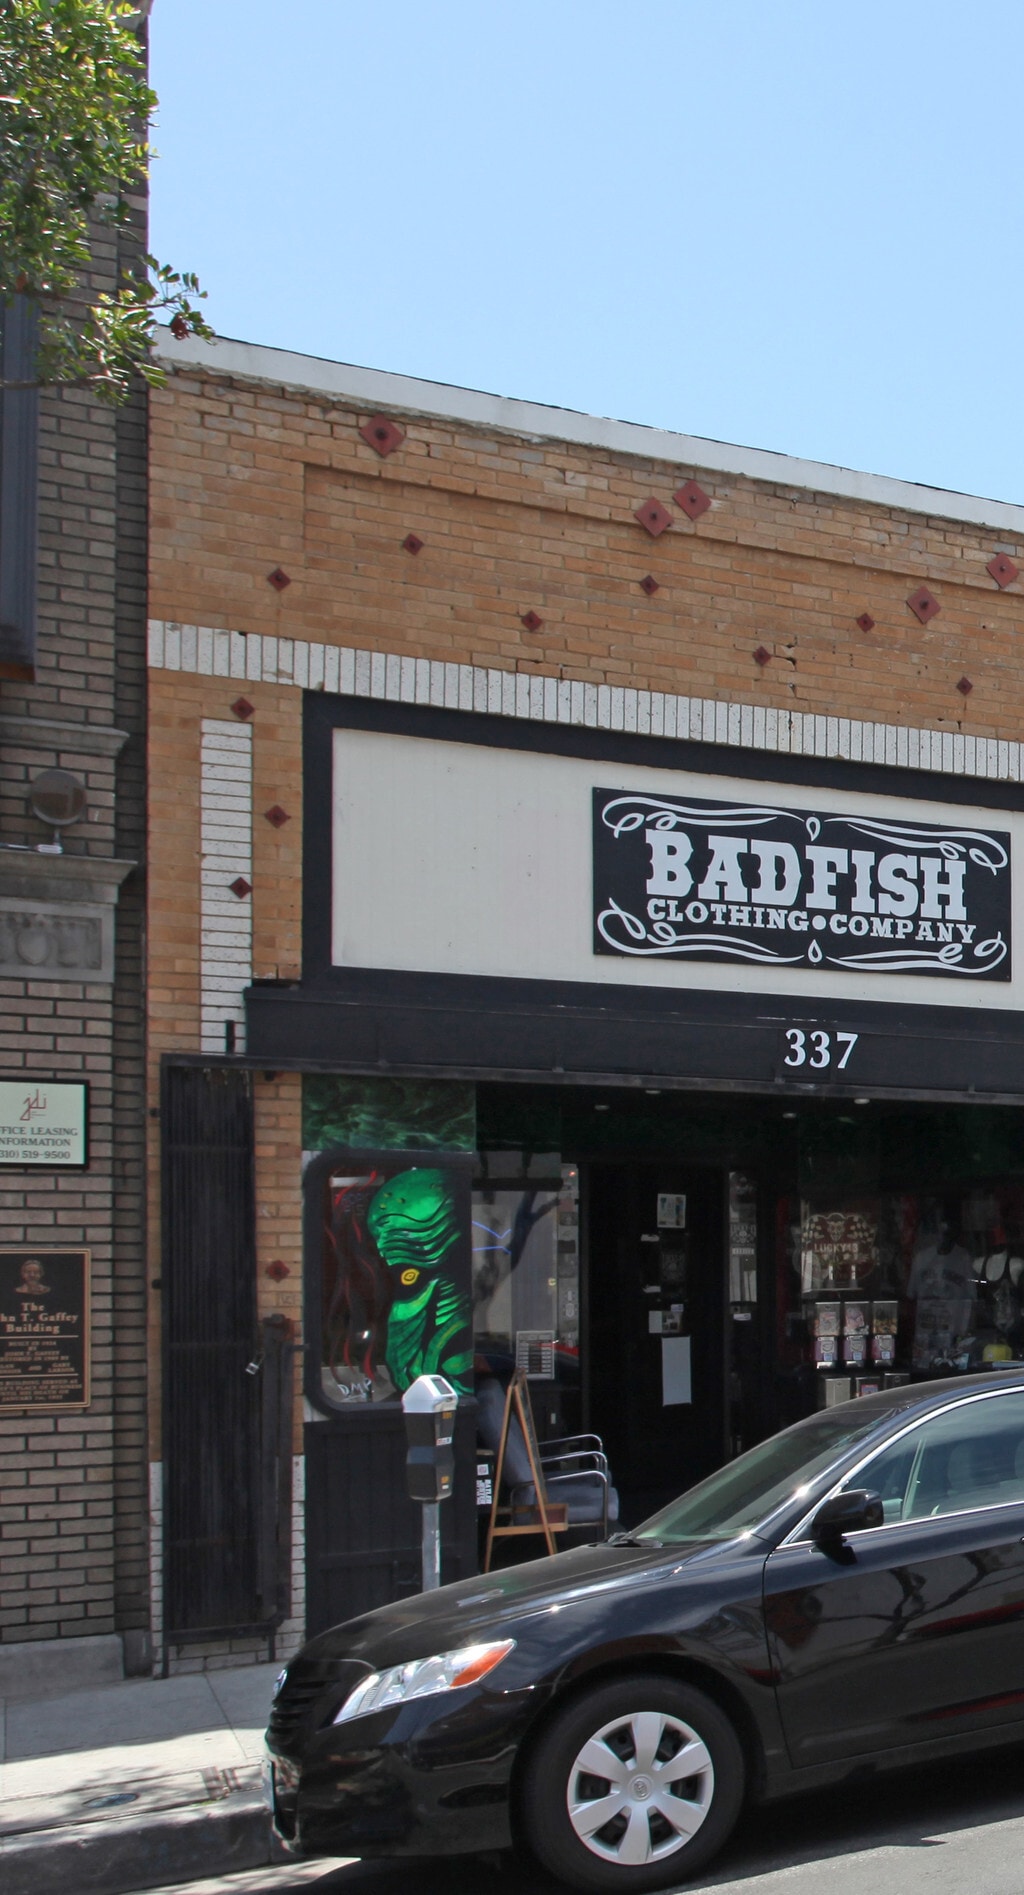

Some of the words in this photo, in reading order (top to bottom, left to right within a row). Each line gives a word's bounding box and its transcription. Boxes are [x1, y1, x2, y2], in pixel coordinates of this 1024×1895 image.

[645, 828, 967, 921] BADFISH
[784, 1028, 858, 1069] 337
[0, 1125, 26, 1135] FICE
[31, 1126, 78, 1136] LEASING
[22, 1150, 71, 1160] 519-9500
[21, 1302, 45, 1312] The
[6, 1323, 60, 1335] Building
